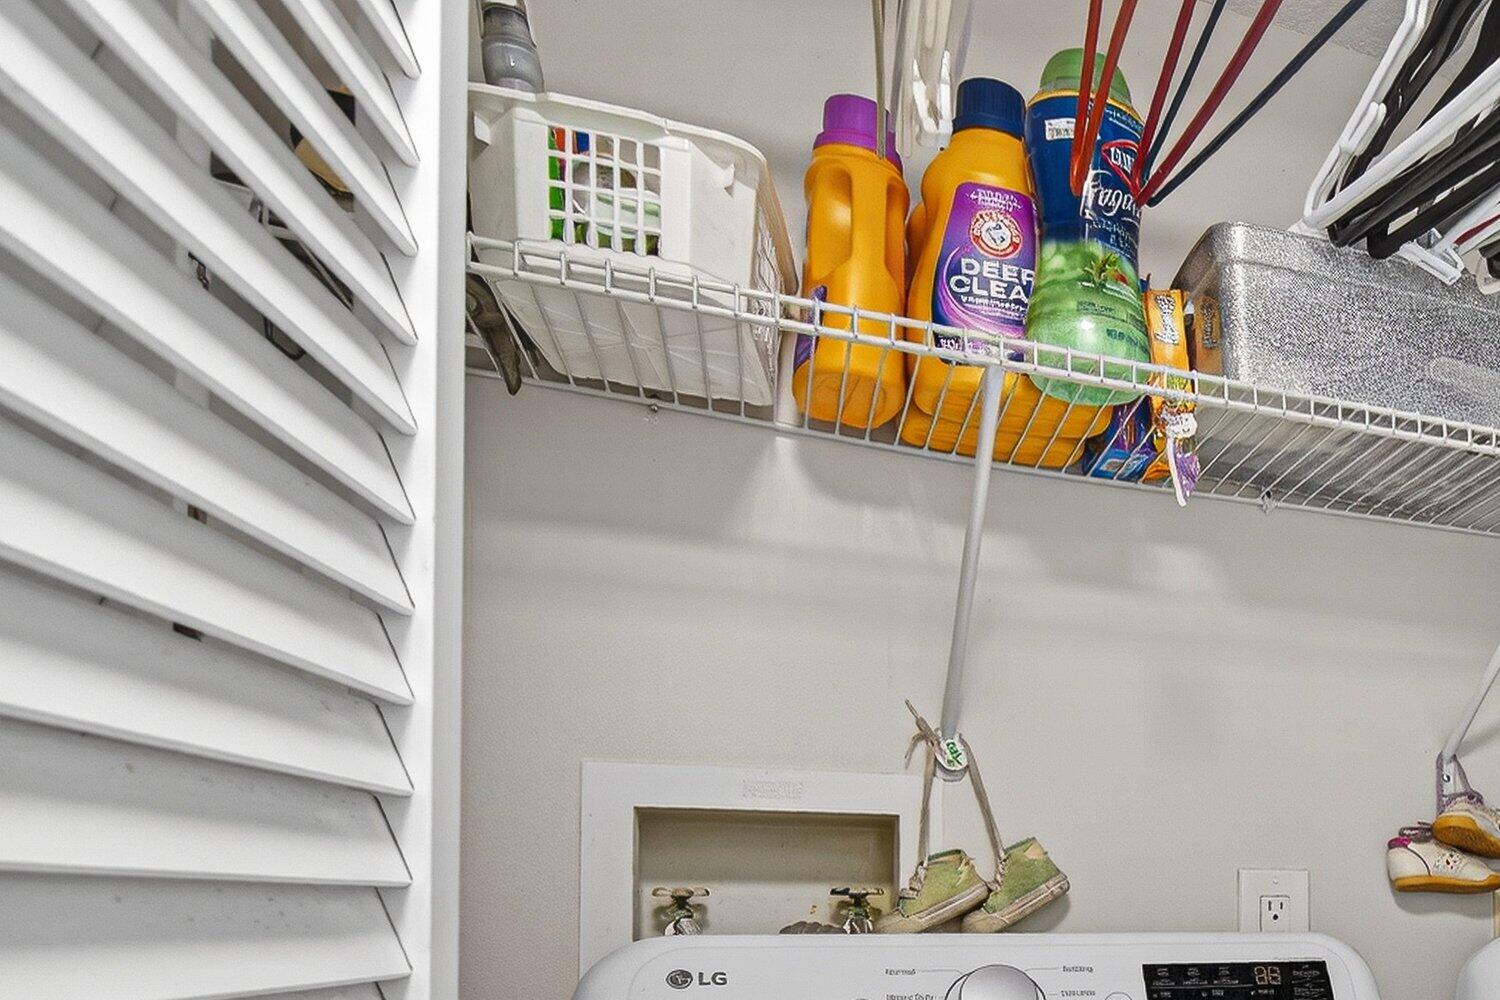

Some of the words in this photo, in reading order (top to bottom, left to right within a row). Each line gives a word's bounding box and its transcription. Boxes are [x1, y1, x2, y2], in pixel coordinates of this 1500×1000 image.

[960, 257, 1036, 286] DEEP
[949, 274, 1034, 304] CLEA
[697, 971, 728, 986] LG
